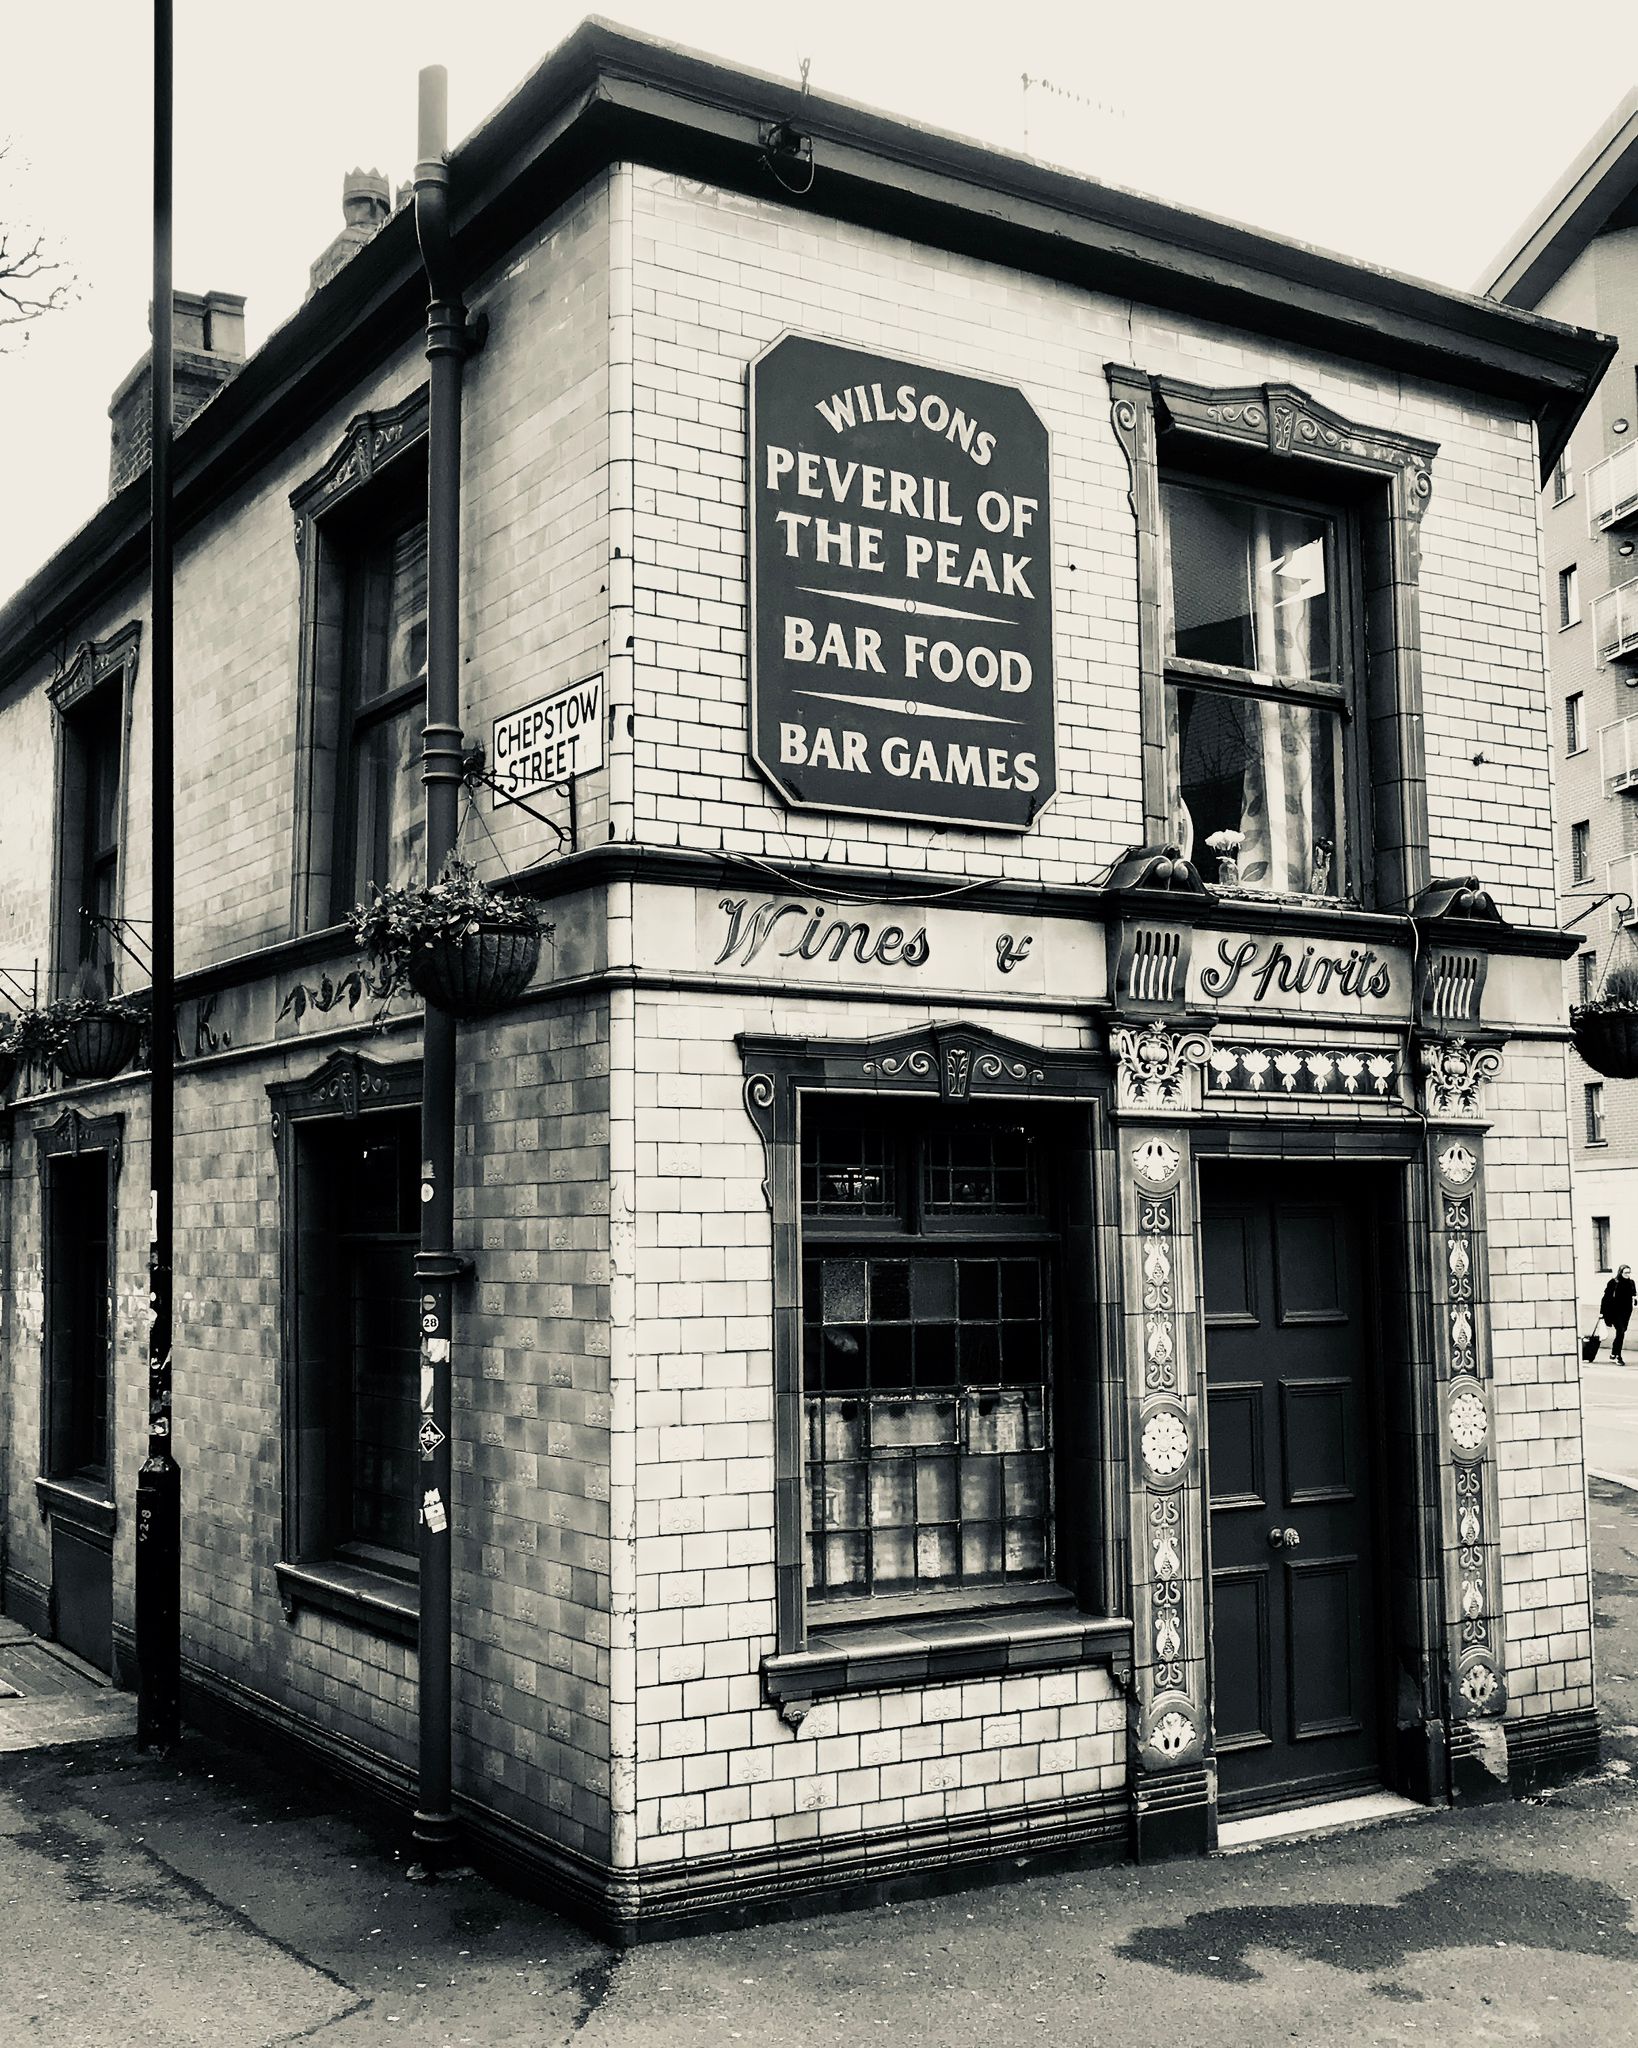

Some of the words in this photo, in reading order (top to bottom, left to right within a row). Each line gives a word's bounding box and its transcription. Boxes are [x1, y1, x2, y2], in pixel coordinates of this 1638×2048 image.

[814, 383, 997, 465] WILSONS
[766, 445, 963, 525] PEVERIL
[976, 490, 1039, 538] OF
[775, 511, 886, 573] THE
[905, 534, 1036, 599] PEAK
[783, 615, 887, 674] BAR
[904, 634, 1033, 693] FOOD
[496, 685, 599, 759] CHEPSTOW
[779, 722, 872, 774] BAR
[880, 736, 1040, 792] GAMES
[508, 734, 580, 793] STREET
[714, 897, 931, 967] Wines
[995, 932, 1035, 974] &
[1200, 937, 1392, 1001] Spirits
[424, 1318, 438, 1328] 28
